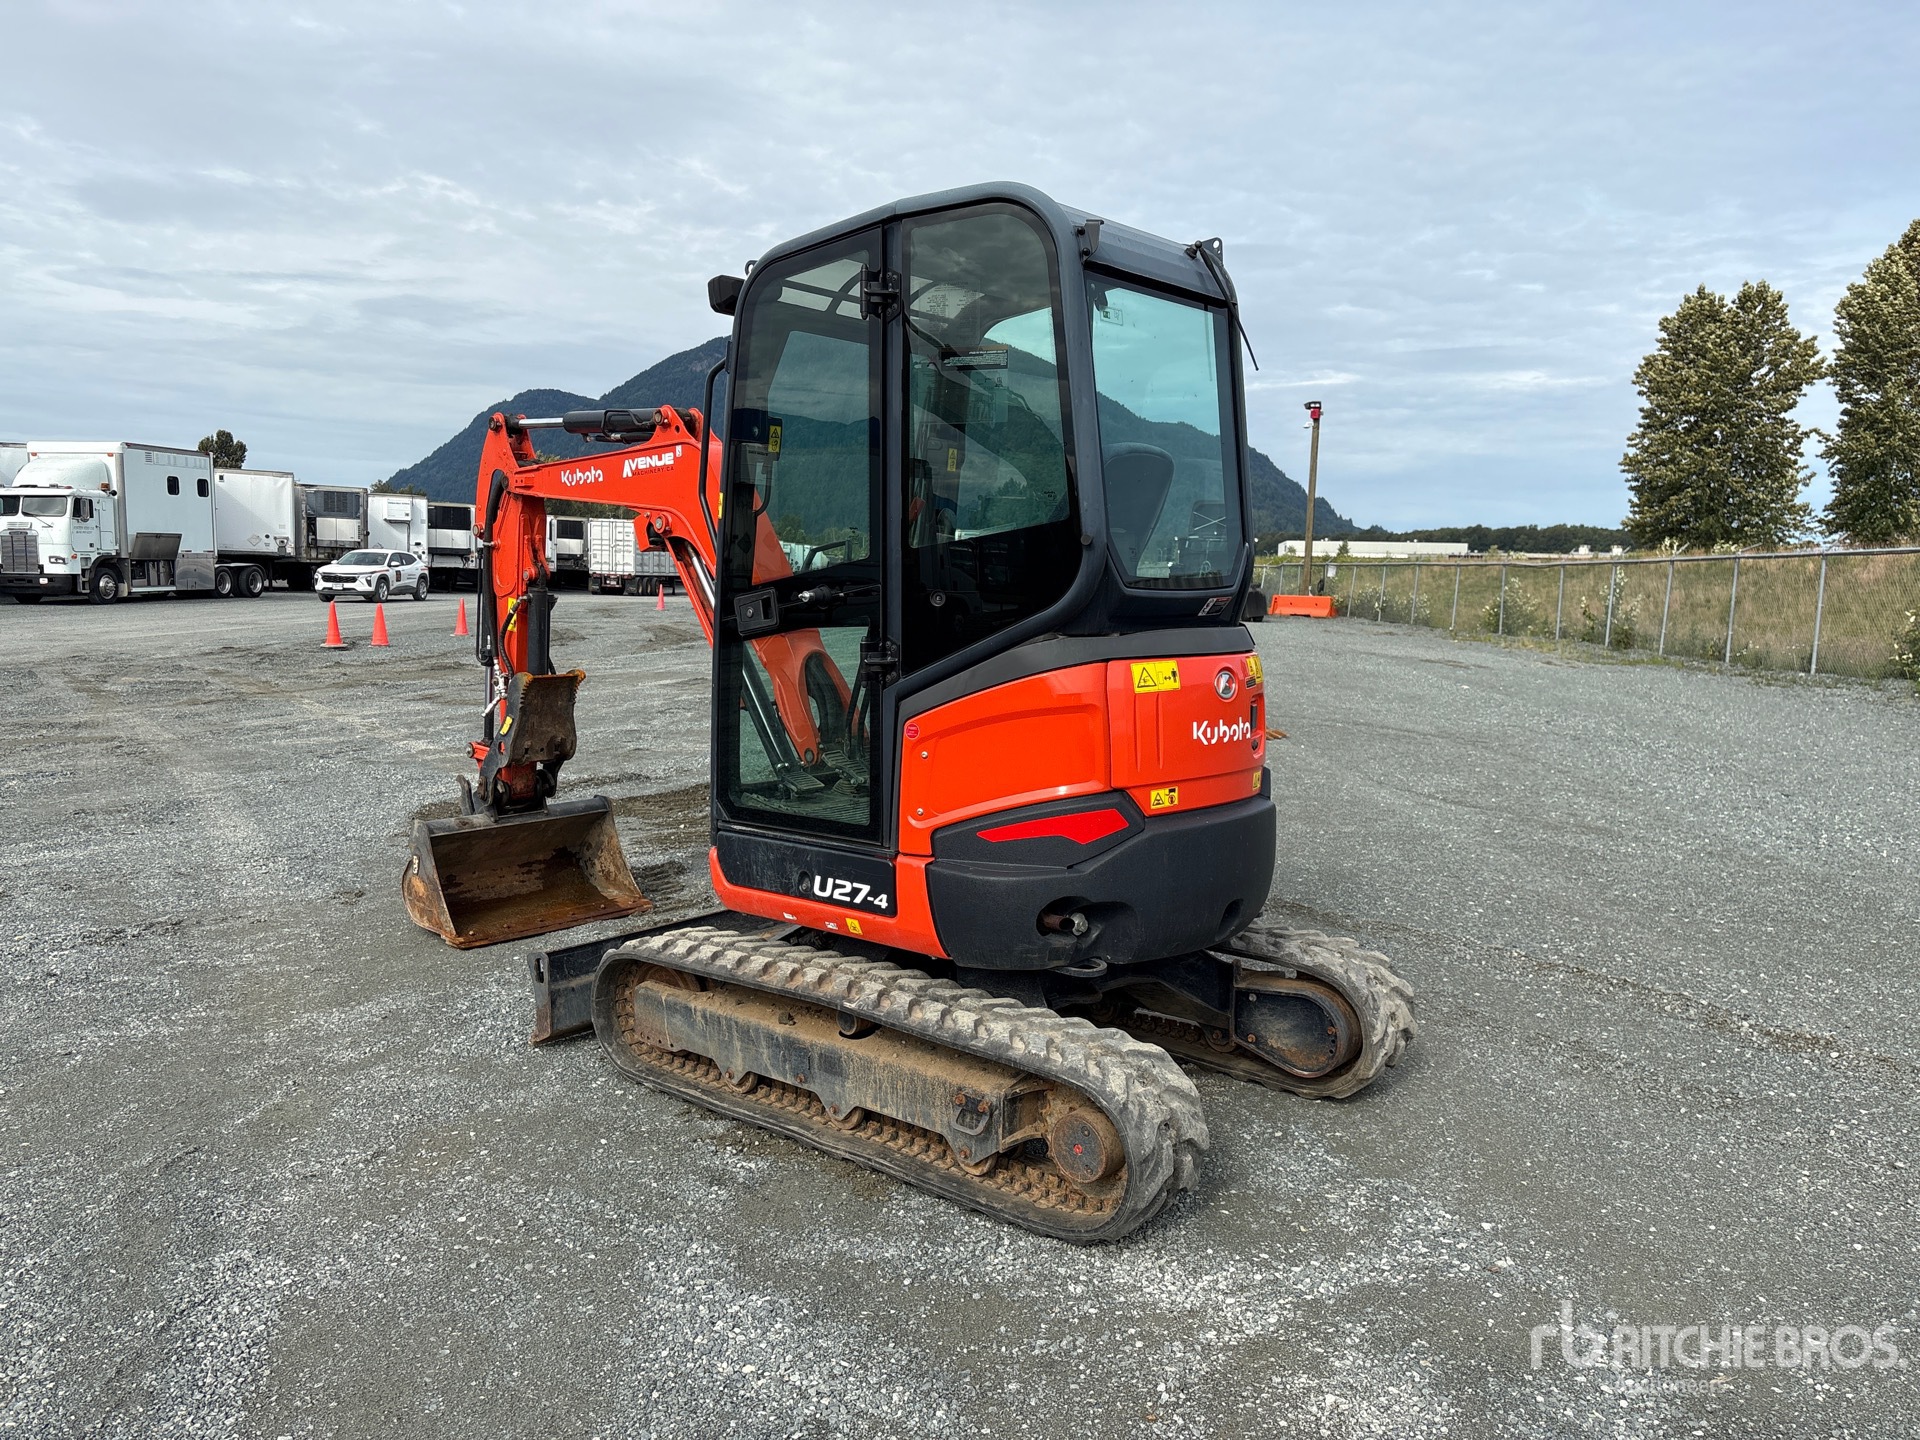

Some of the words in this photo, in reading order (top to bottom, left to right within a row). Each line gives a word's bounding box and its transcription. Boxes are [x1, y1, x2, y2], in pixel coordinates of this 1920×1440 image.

[560, 466, 604, 486] Kubota
[622, 452, 675, 478] AVENUE
[1192, 716, 1252, 746] Kubota
[813, 875, 889, 910] U27-4
